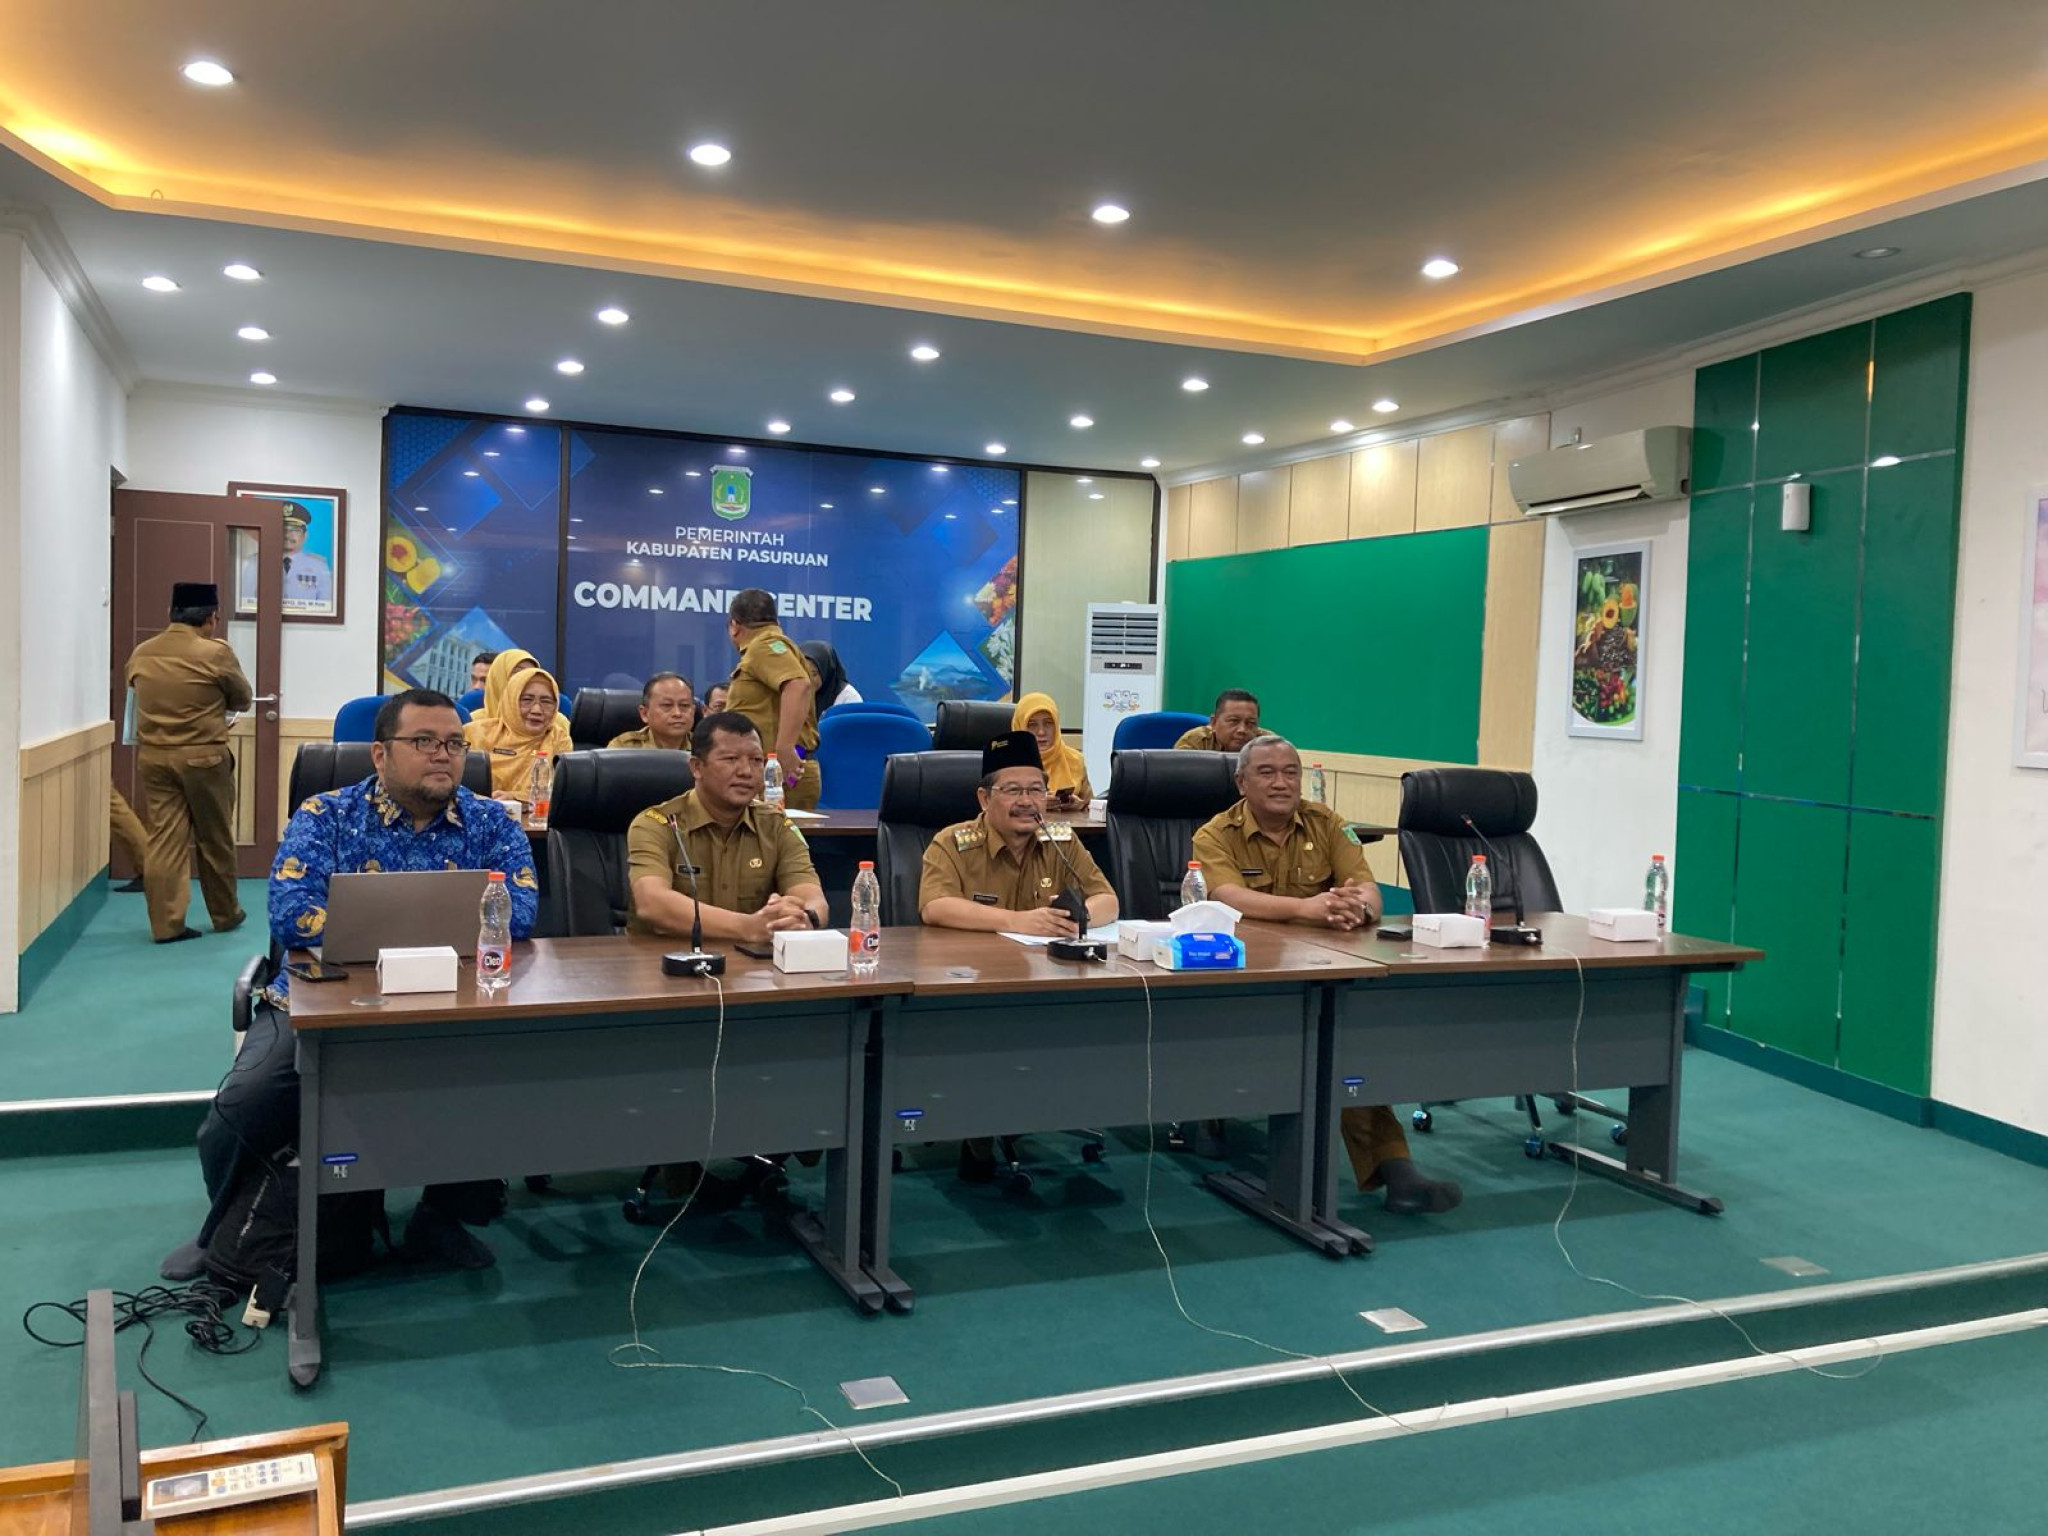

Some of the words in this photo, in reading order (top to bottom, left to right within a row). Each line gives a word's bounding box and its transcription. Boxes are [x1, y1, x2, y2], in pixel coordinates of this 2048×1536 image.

[675, 525, 784, 546] PEMERINTAH
[626, 541, 733, 562] KABUPATEN
[737, 547, 829, 567] PASURUAN
[768, 592, 872, 621] ENTER
